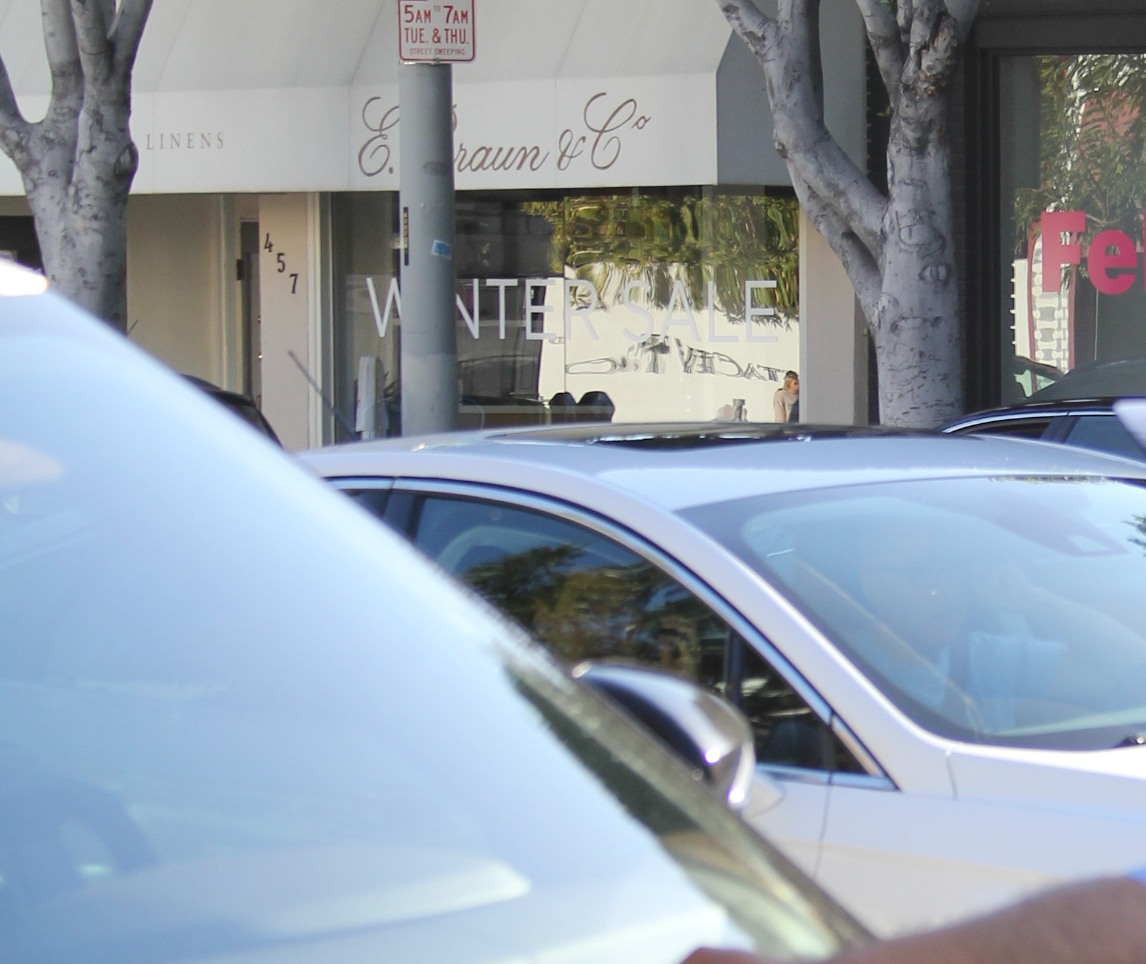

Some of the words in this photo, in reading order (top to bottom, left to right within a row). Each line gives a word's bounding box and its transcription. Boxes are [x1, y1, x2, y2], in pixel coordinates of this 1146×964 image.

[404, 4, 431, 23] 5AM
[443, 5, 468, 24] 7AM
[404, 28, 429, 43] TUE.
[432, 28, 441, 44] &
[444, 28, 469, 44] THU.
[146, 132, 224, 150] LINENS
[452, 103, 550, 172] raun
[366, 277, 599, 342] WNTER
[622, 279, 779, 344] SALE
